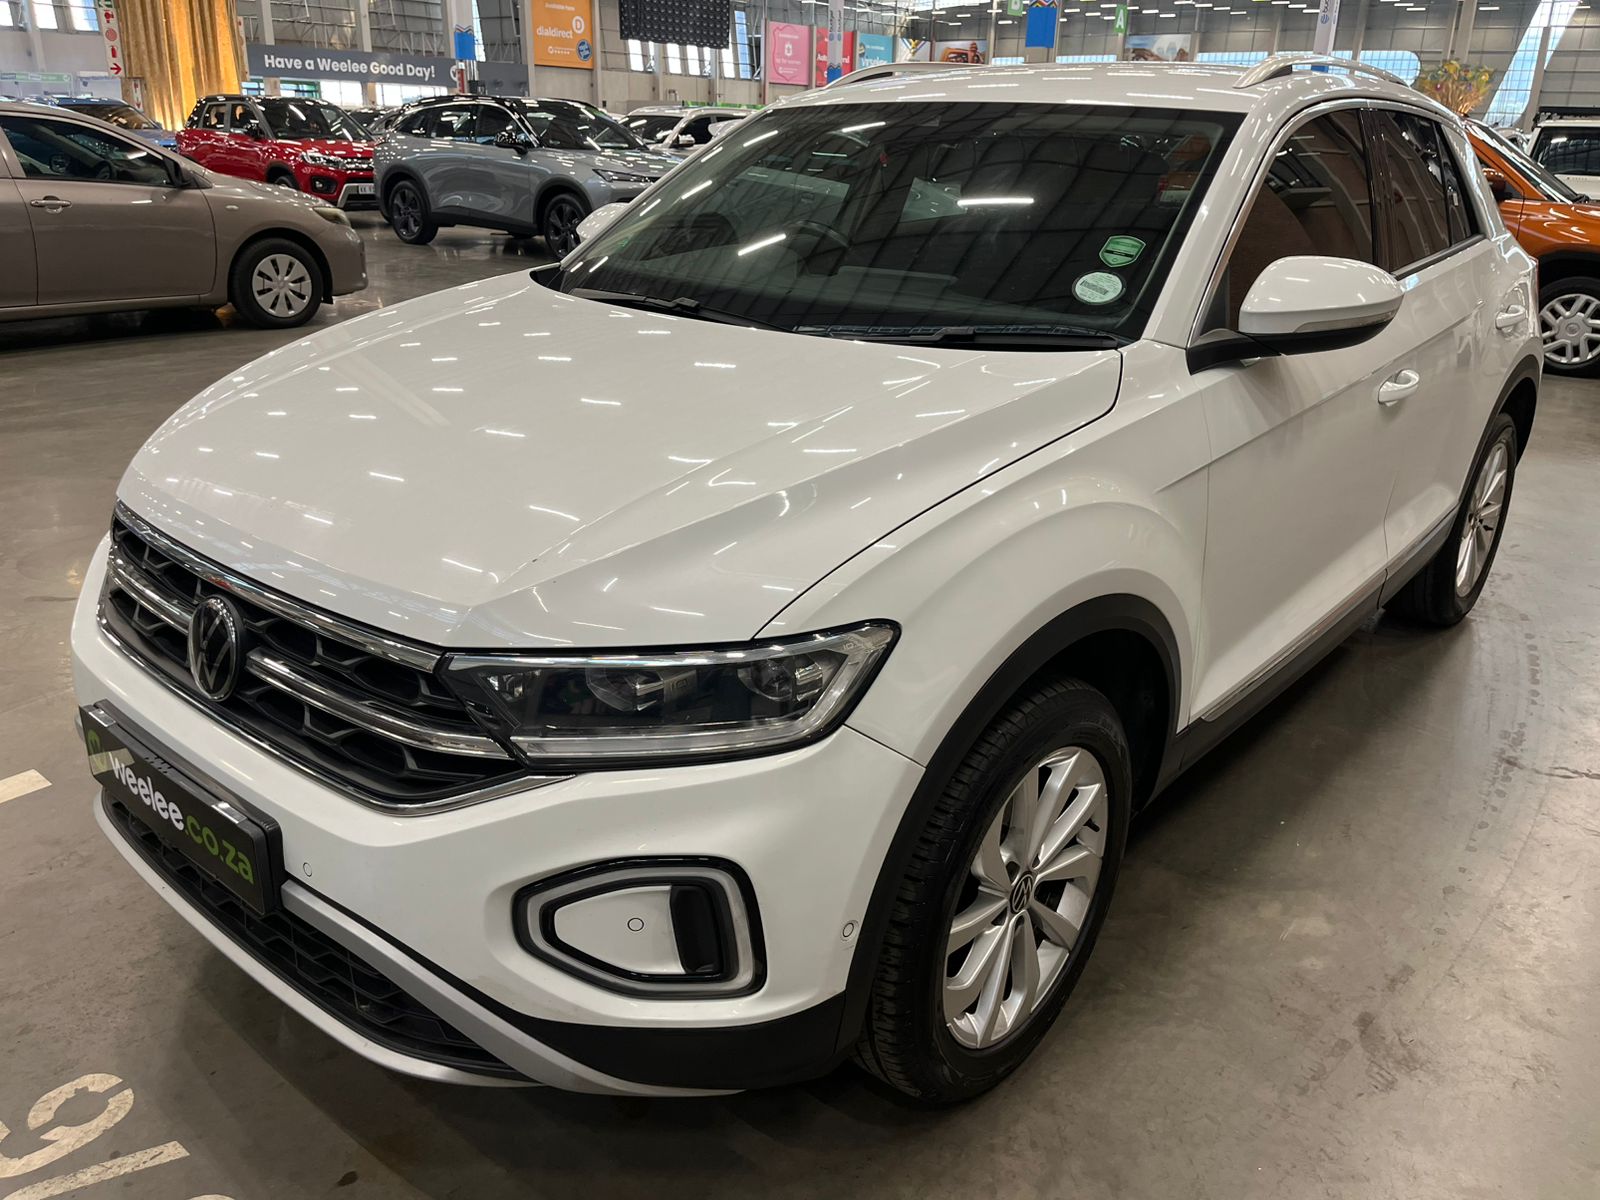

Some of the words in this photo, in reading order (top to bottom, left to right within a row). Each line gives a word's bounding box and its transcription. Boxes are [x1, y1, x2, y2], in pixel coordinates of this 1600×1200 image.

[536, 25, 574, 39] dialdirect
[264, 54, 302, 69] Have
[305, 59, 314, 71] a
[316, 57, 368, 74] Weelee
[370, 61, 404, 76] Good
[406, 64, 435, 82] Day!
[109, 751, 254, 884] weelee.co.za
